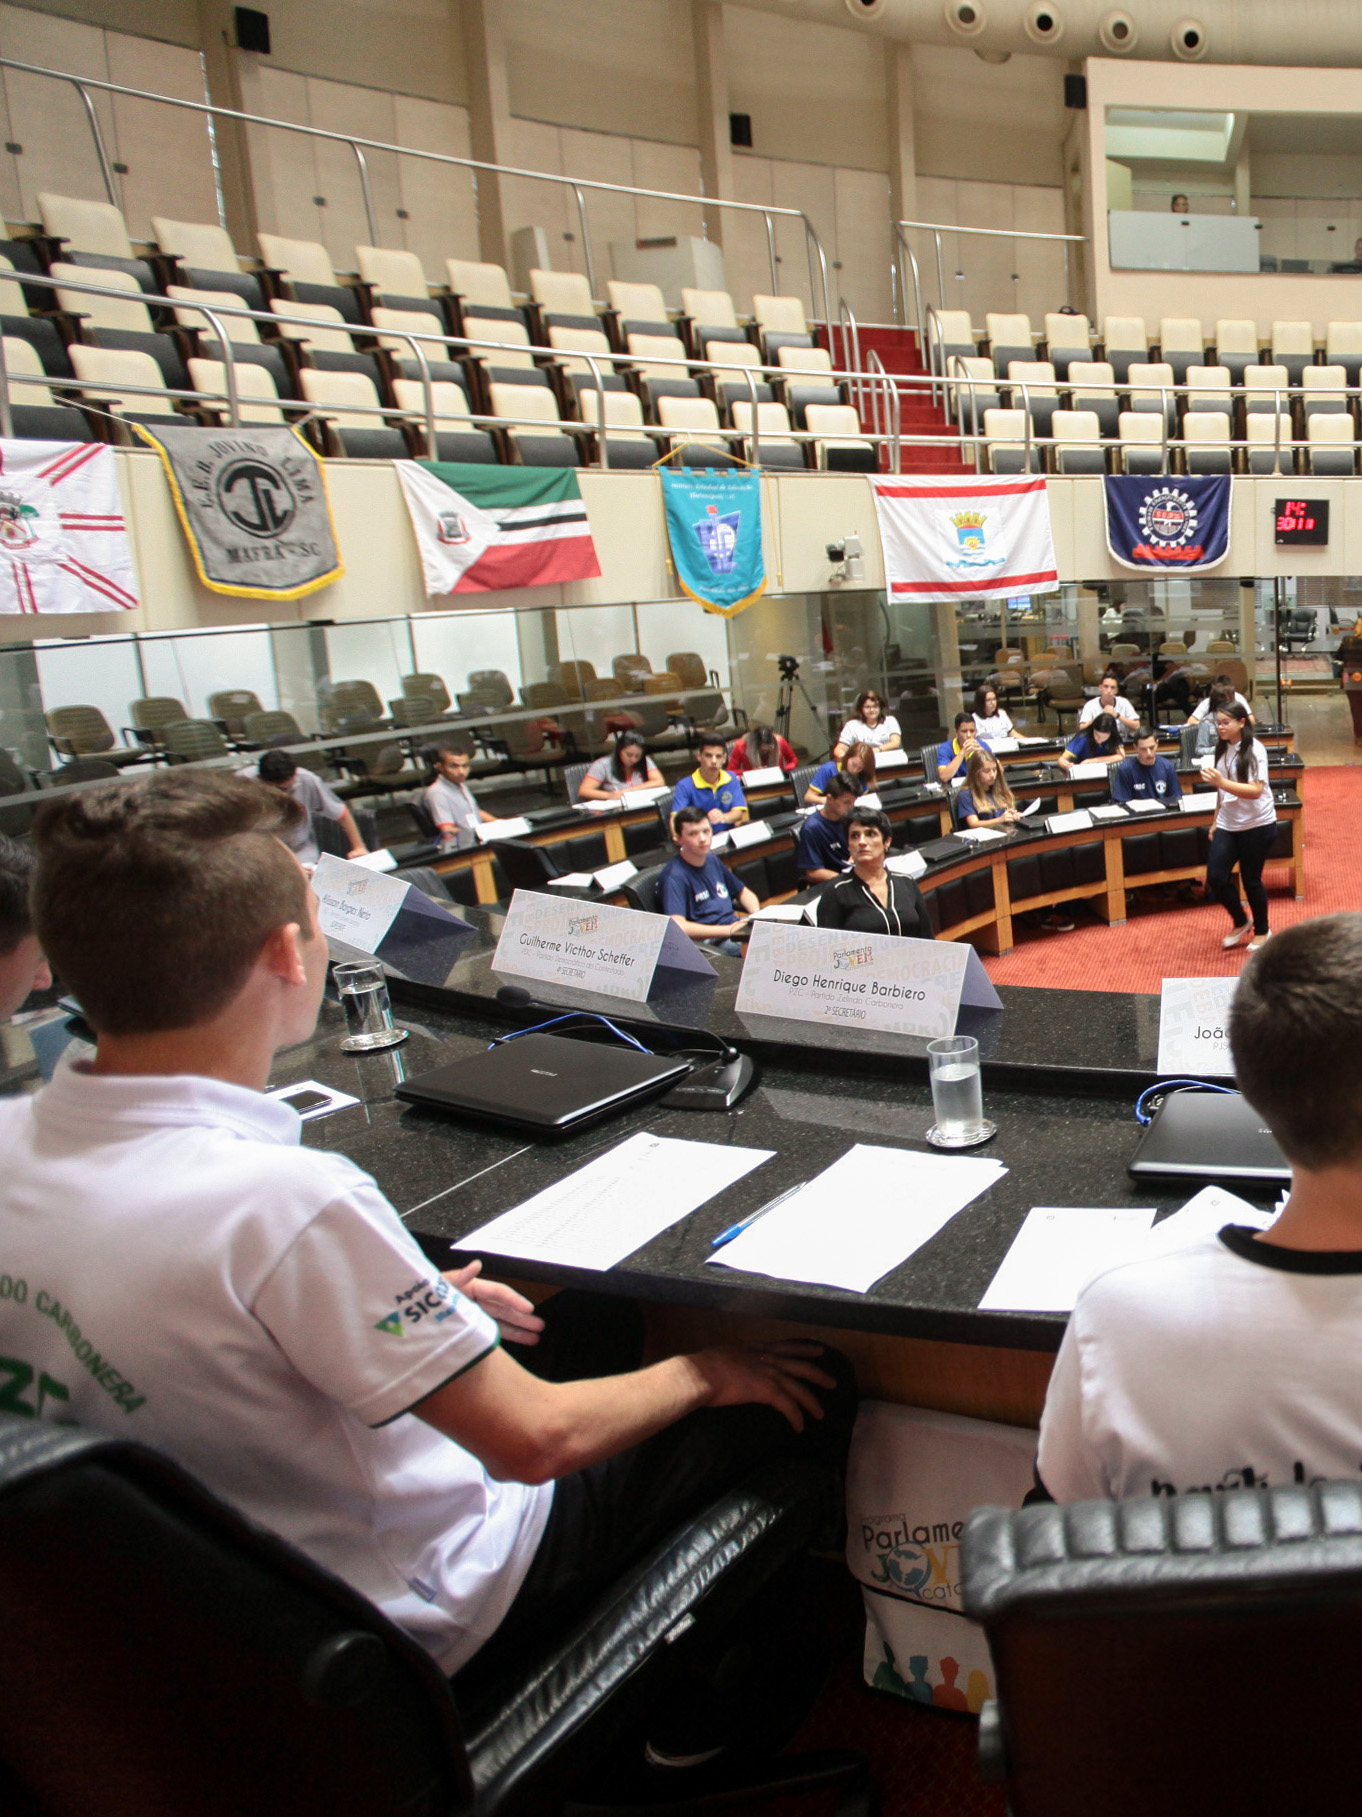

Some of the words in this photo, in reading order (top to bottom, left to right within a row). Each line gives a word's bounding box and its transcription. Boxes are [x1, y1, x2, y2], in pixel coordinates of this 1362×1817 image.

[519, 933, 561, 952] Guilherme
[564, 941, 596, 958] Victhor
[597, 948, 635, 967] Scheffer
[833, 945, 873, 960] Parlamento
[773, 969, 809, 987] Diego
[812, 974, 867, 995] Henrique
[871, 981, 926, 1001] Barbiero
[35, 1290, 147, 1414] CARBONERA
[862, 1520, 964, 1550] Parlame
[870, 1542, 955, 1592] JOV
[922, 1583, 962, 1600] cata
